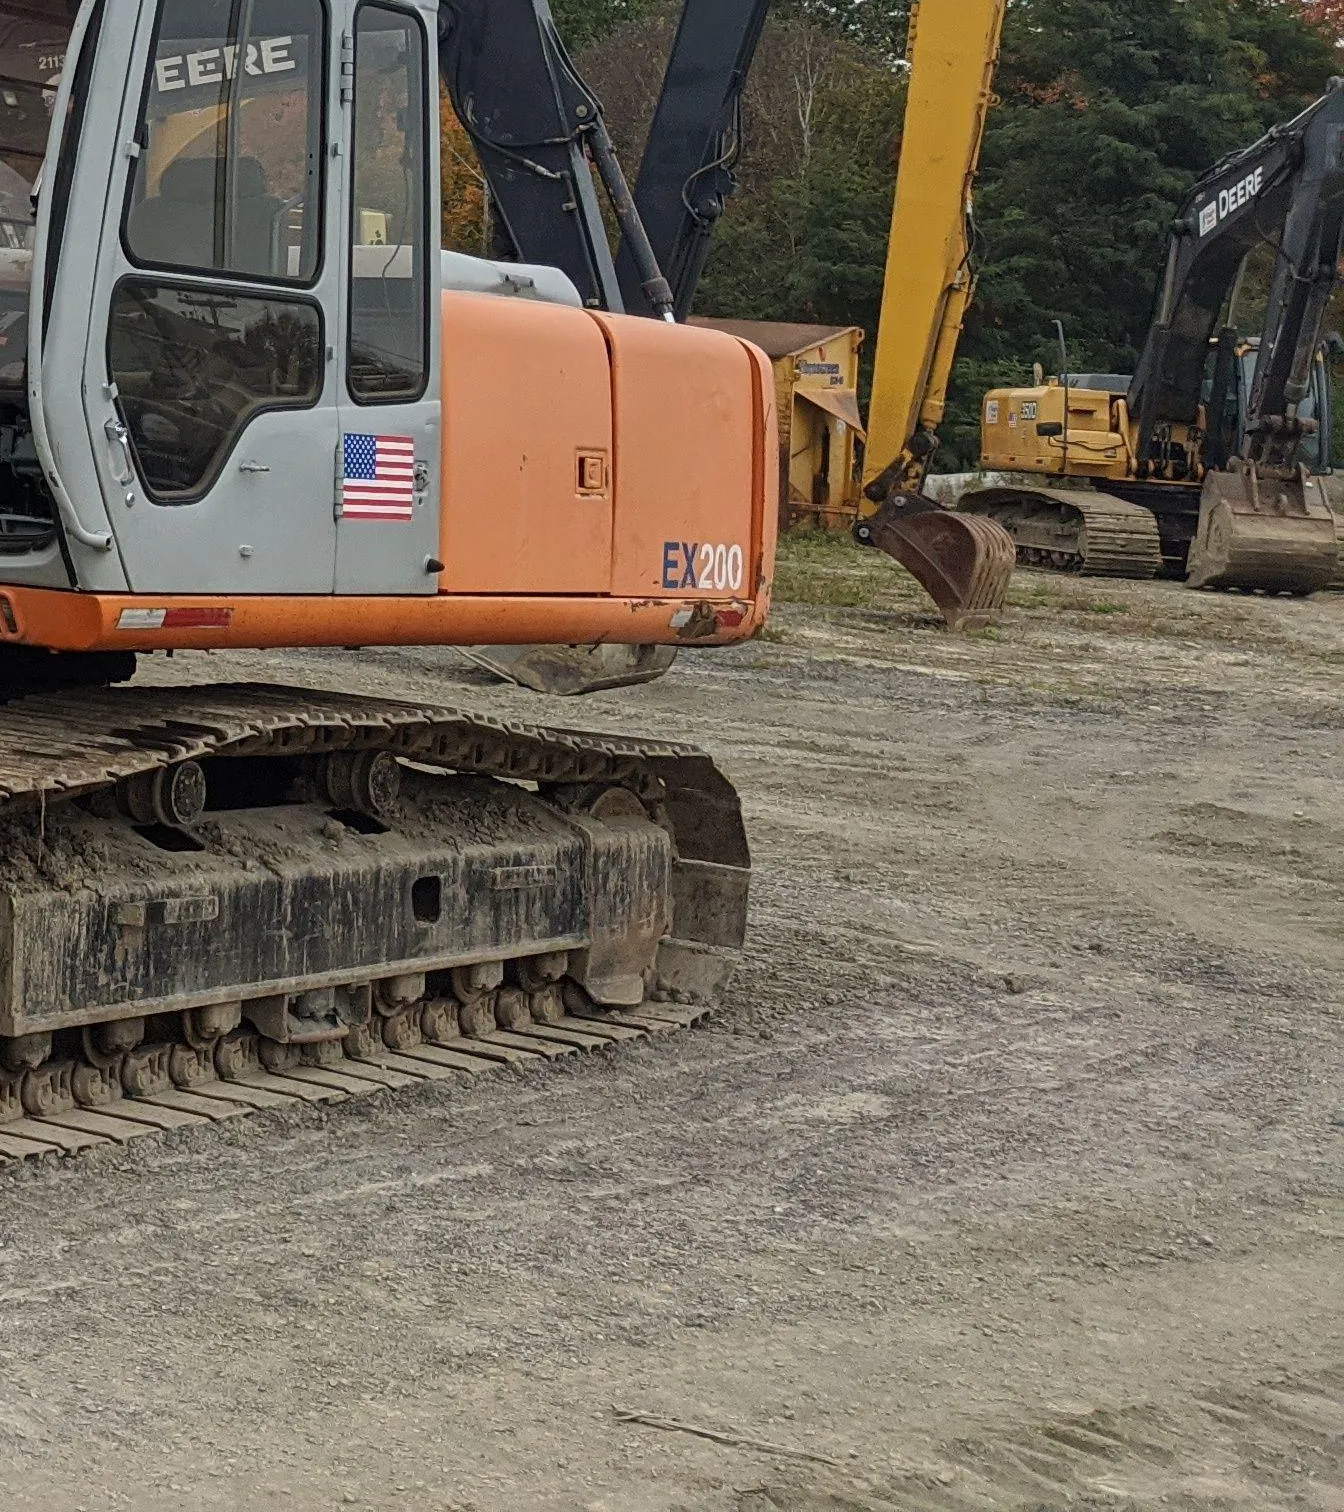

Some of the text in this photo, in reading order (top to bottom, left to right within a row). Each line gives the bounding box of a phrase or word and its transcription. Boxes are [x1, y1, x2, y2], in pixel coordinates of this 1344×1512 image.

[155, 35, 296, 92] EERE
[1218, 165, 1263, 220] DEERE
[662, 541, 743, 591] EX200
